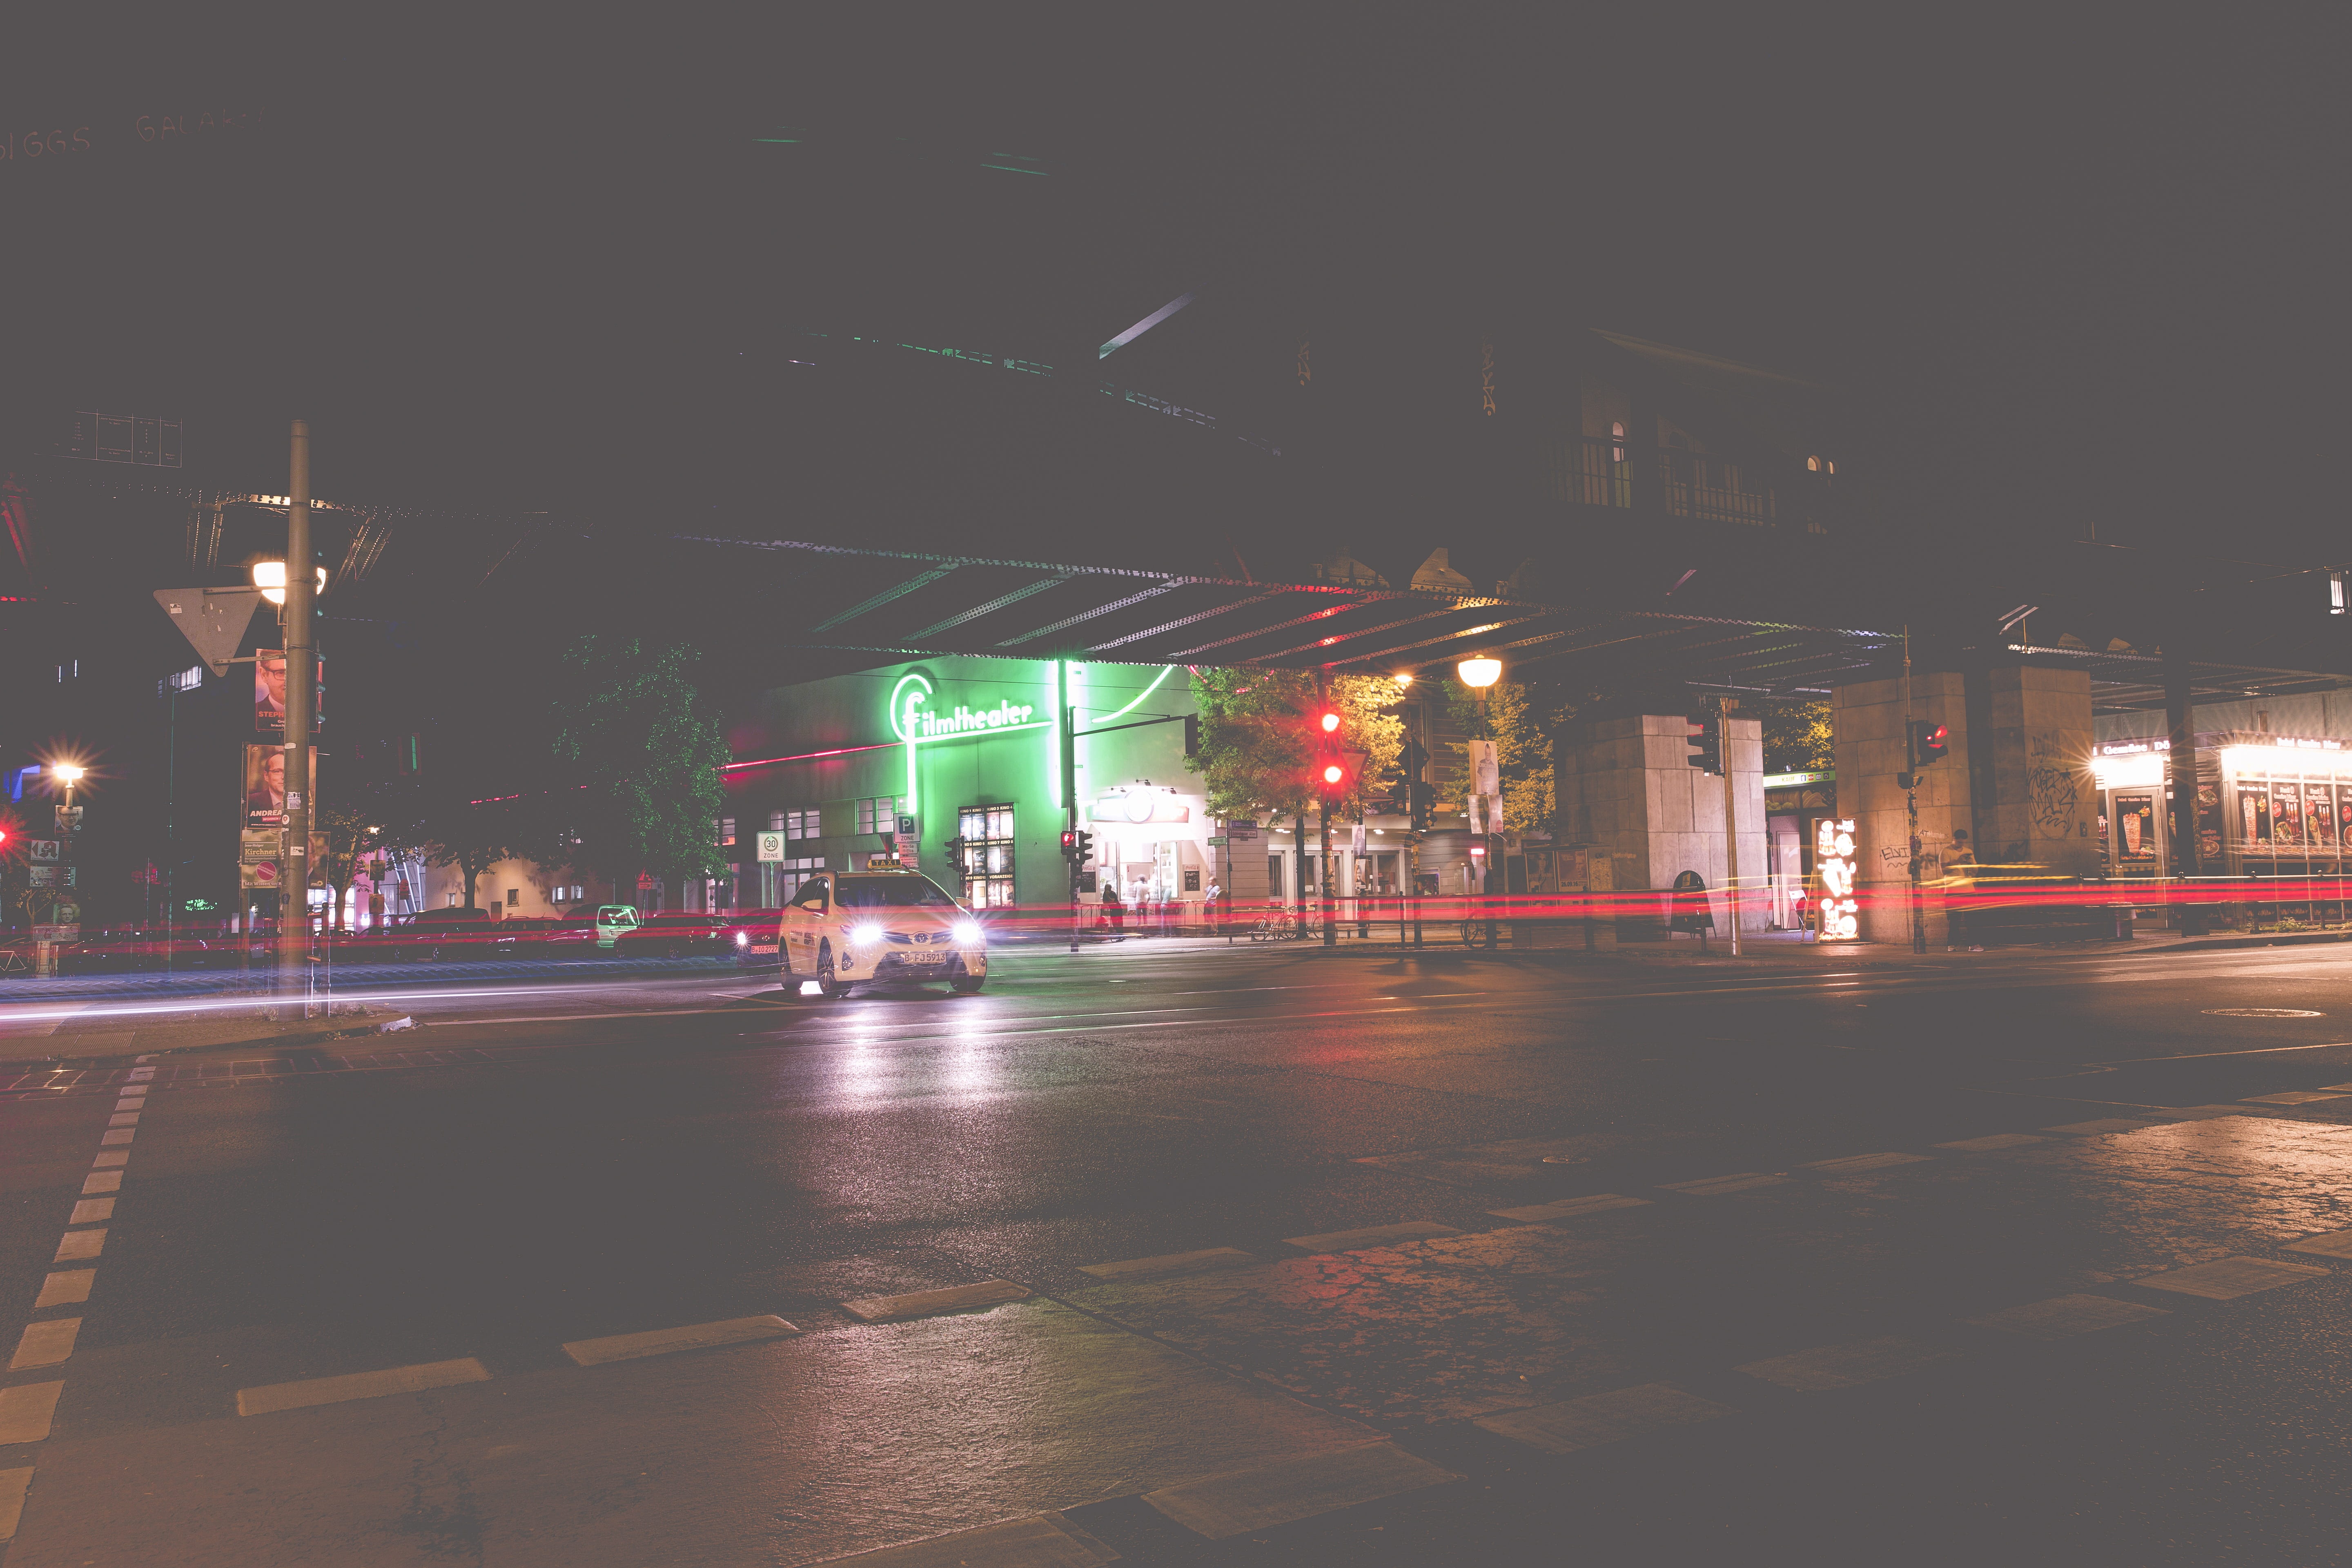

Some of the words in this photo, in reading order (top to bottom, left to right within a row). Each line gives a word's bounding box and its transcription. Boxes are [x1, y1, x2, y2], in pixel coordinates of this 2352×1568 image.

[2104, 744, 2147, 755] Gemüse
[902, 818, 911, 831] P
[927, 953, 945, 961] 5913
